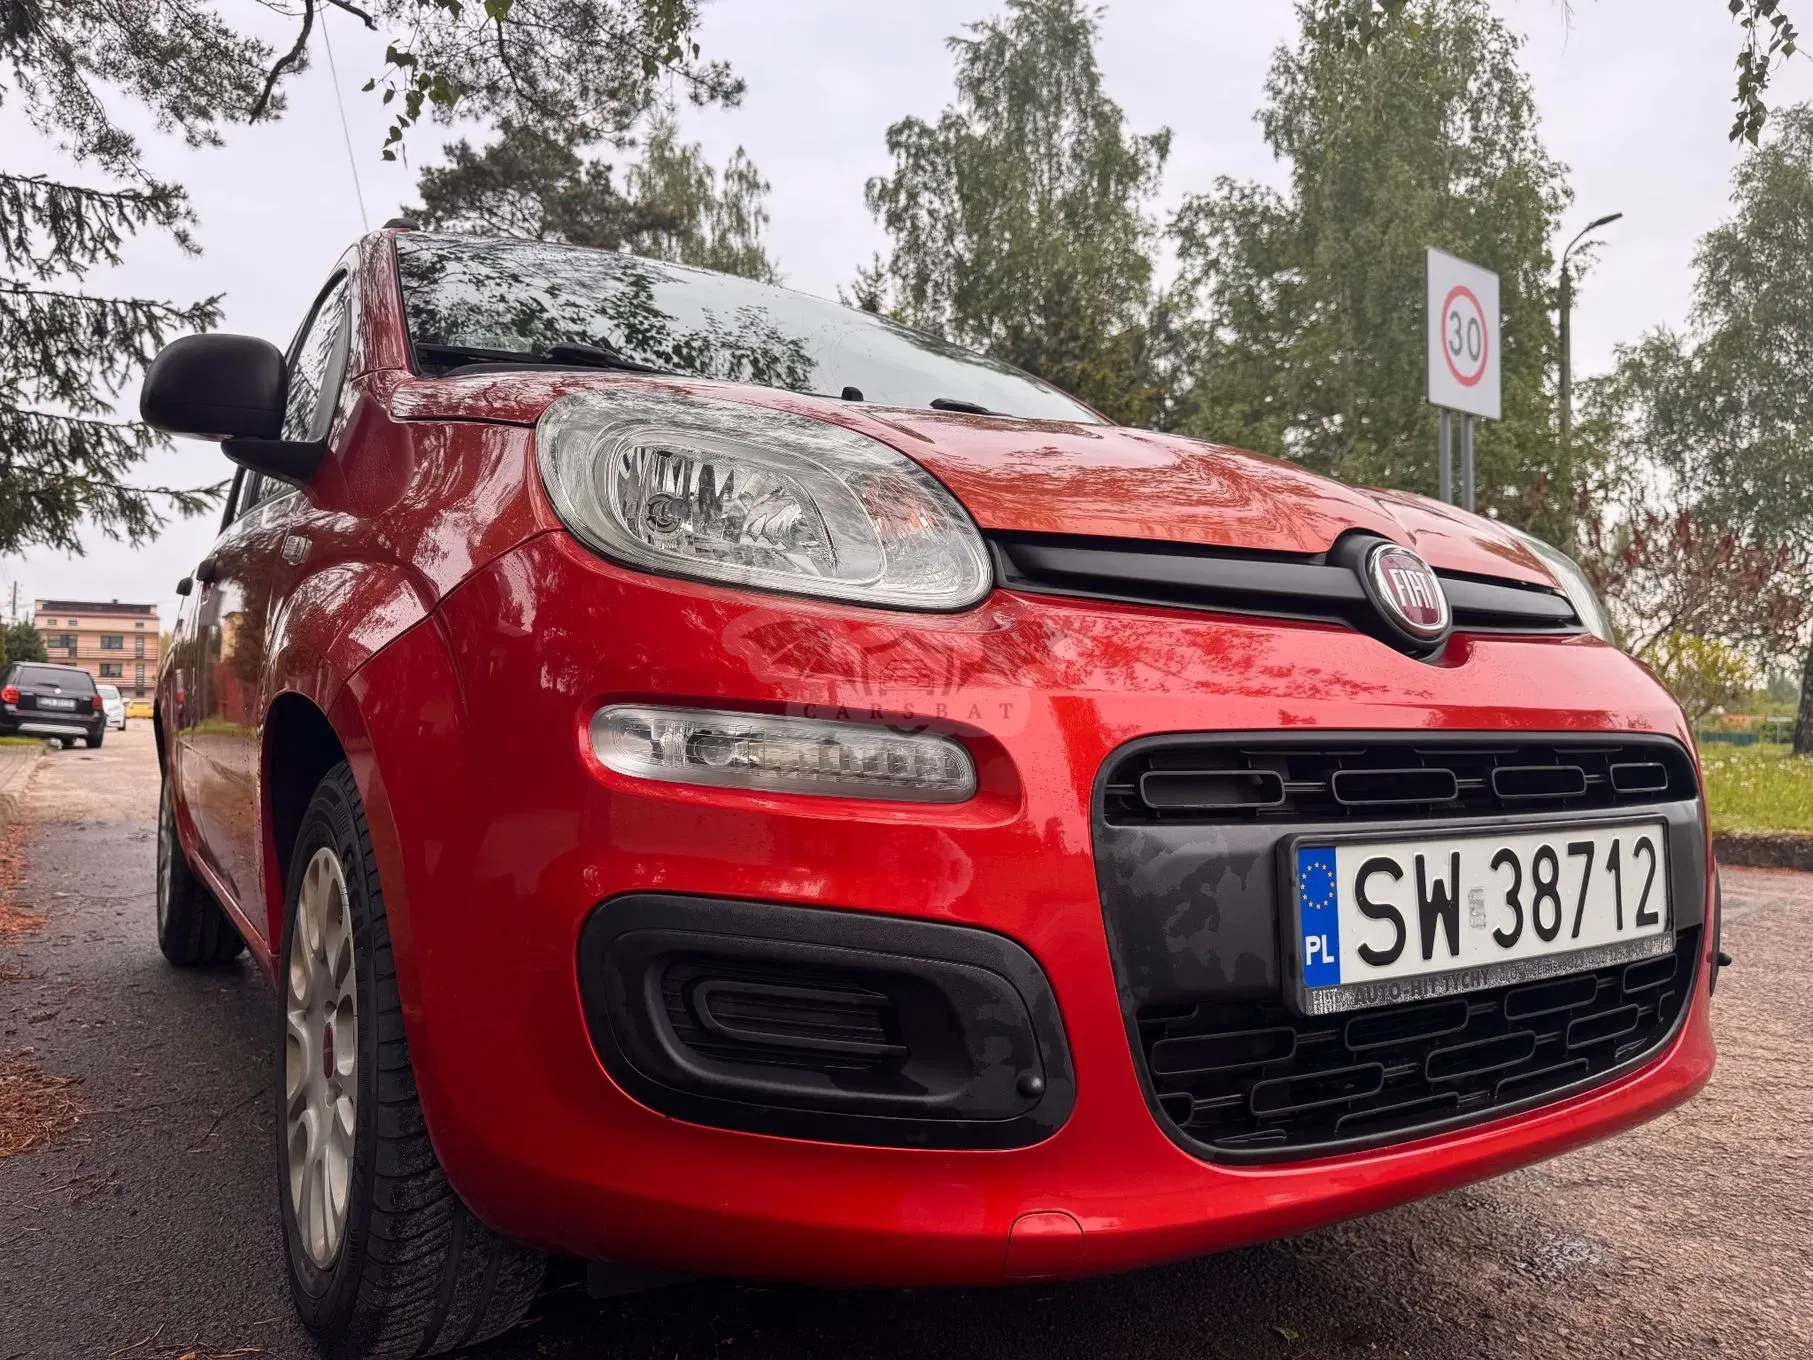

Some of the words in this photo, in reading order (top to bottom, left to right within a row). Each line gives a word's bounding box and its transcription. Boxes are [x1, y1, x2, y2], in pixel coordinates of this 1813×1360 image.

[1449, 310, 1482, 362] 30
[1388, 568, 1436, 610] FIAT
[1354, 851, 1461, 967] SW
[1489, 836, 1660, 949] 38712
[1305, 934, 1335, 966] PL
[1442, 968, 1491, 992] TYCHY
